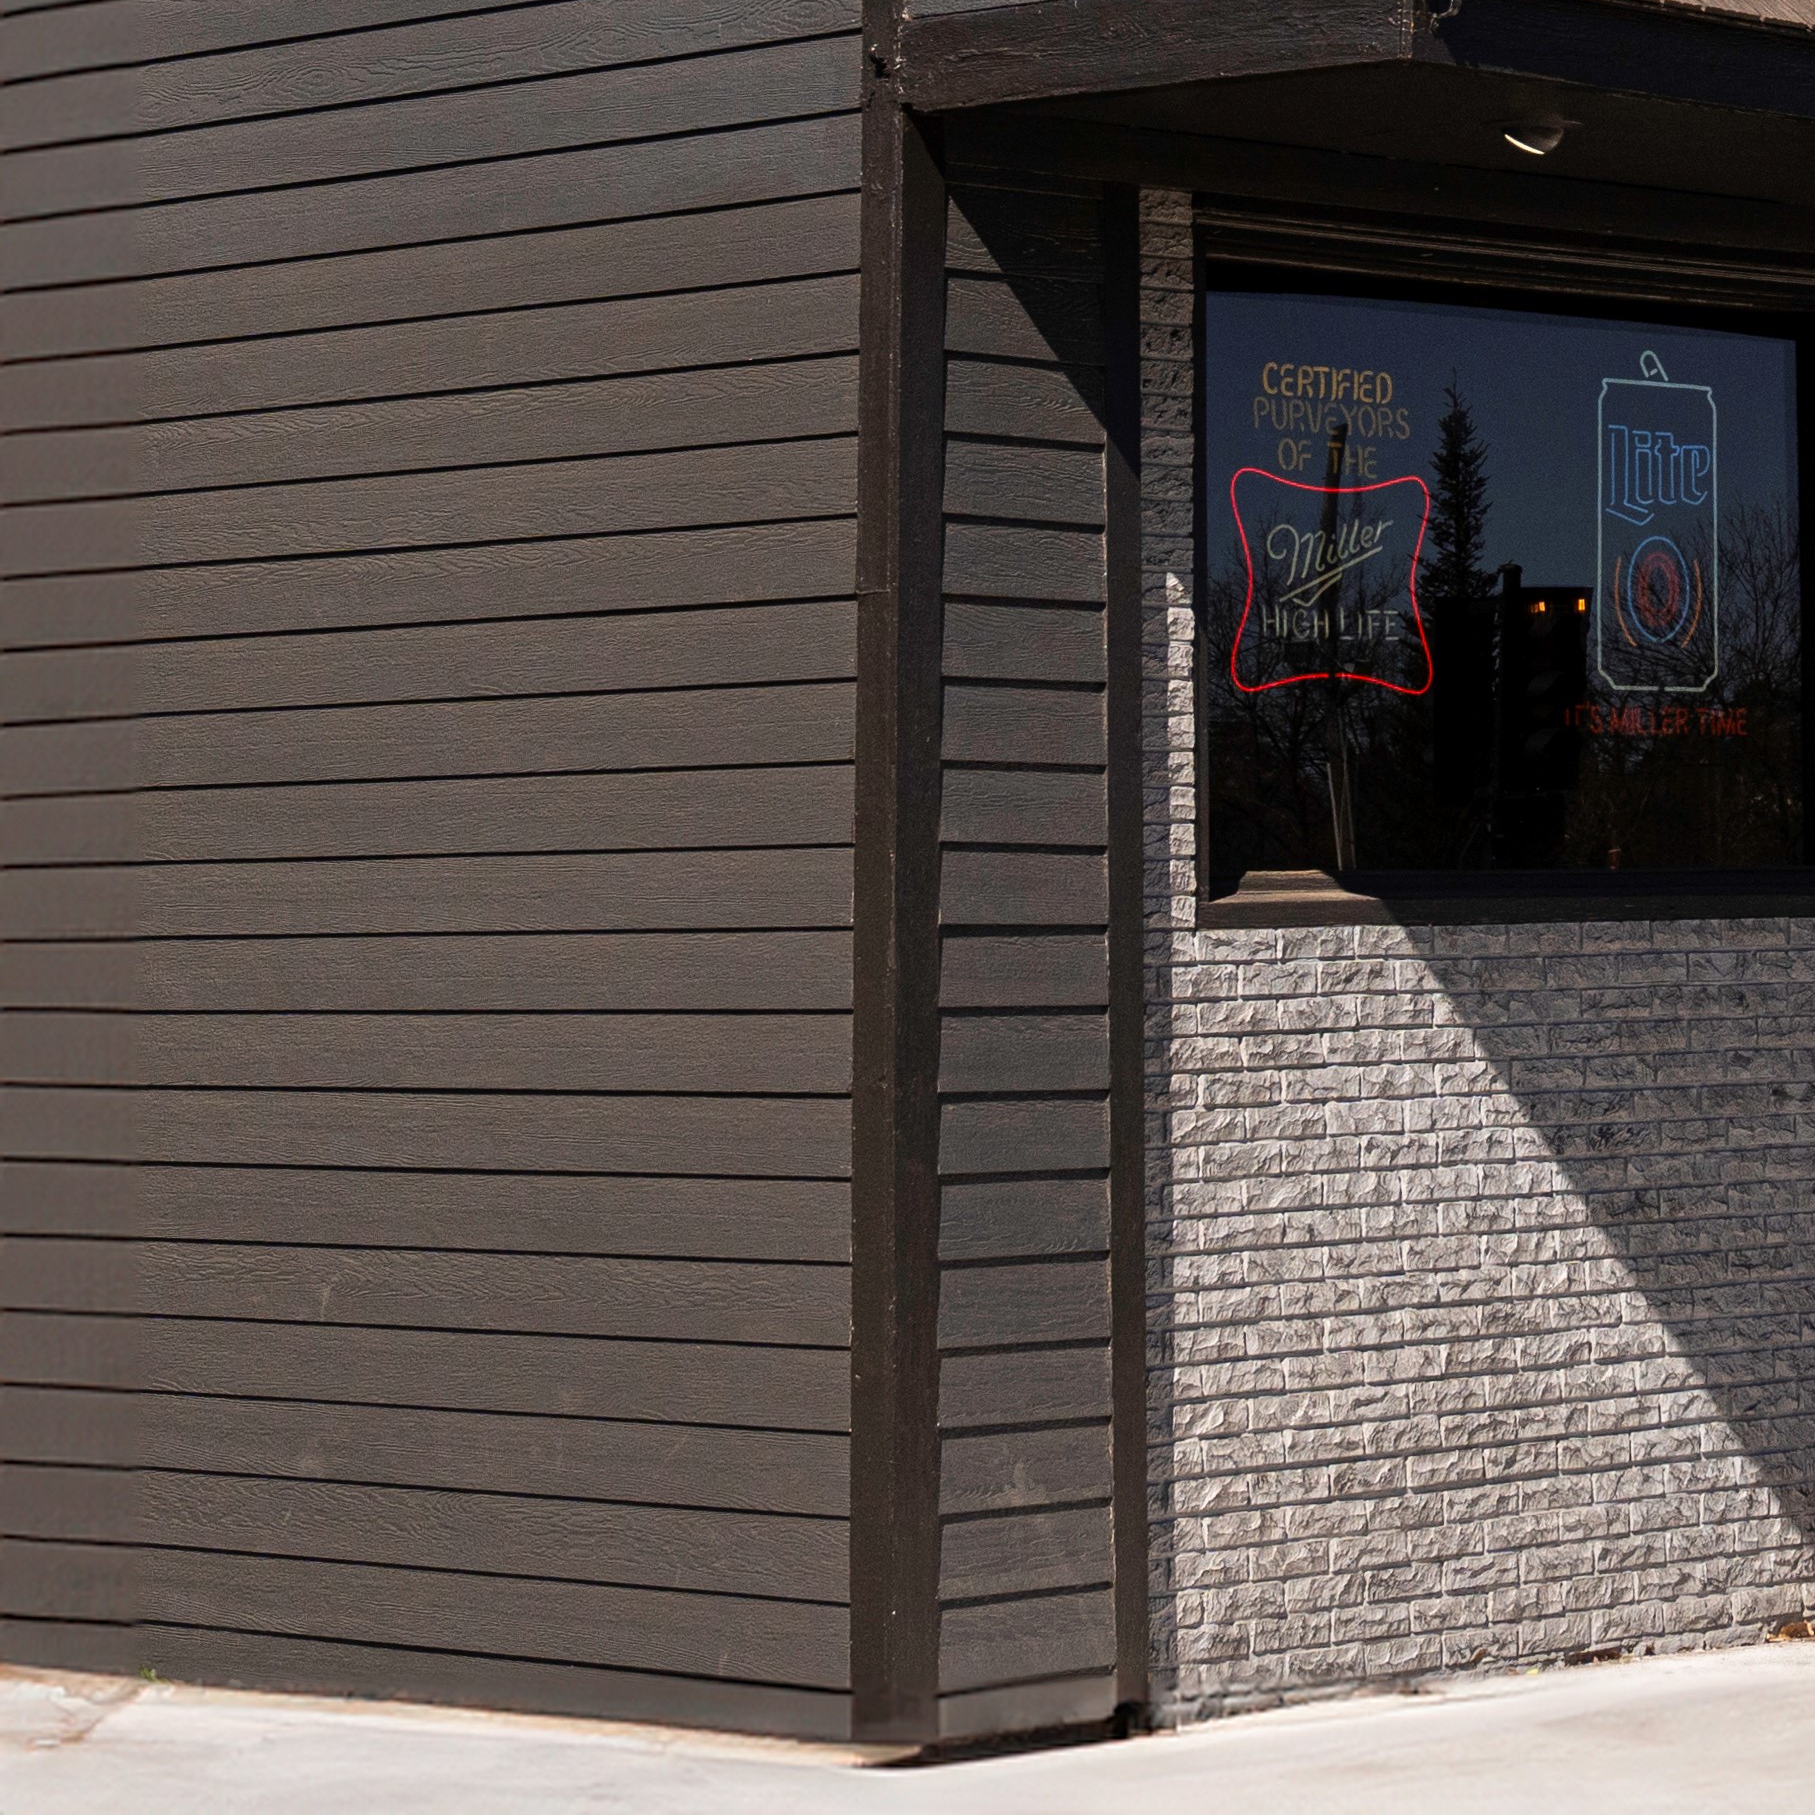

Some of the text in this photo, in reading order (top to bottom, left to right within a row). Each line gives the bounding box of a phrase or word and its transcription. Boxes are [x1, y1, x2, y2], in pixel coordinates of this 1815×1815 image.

[1262, 361, 1393, 404] CERTIFIED
[1253, 396, 1411, 440] PURVEYORS
[1277, 437, 1378, 479] OF THE
[1605, 424, 1711, 526] Lite
[1266, 518, 1394, 586] Miller
[1262, 604, 1400, 641] HIGH LIFE
[1562, 700, 1751, 738] IT'S MILLER TIME
